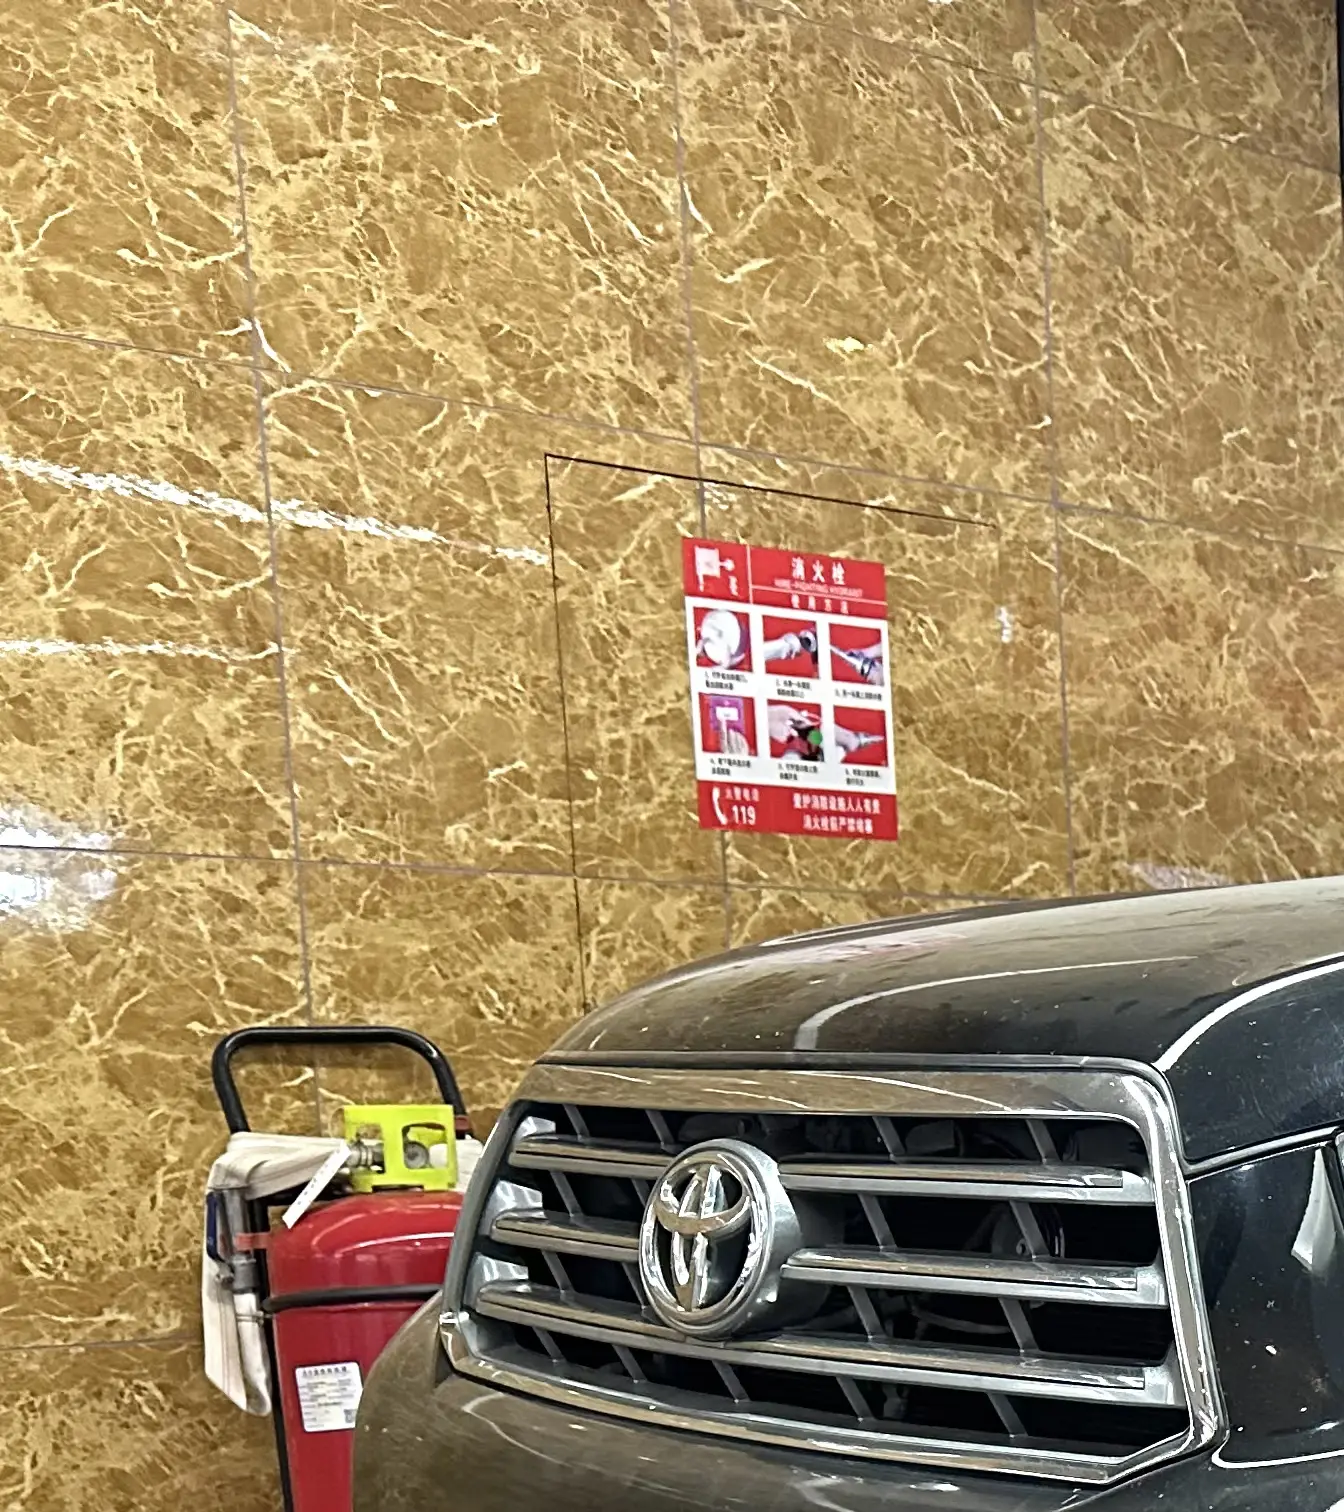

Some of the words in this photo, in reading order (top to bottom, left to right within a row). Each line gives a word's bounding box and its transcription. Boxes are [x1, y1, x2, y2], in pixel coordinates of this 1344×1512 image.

[791, 556, 845, 586] 消火栓
[732, 804, 757, 826] 119
